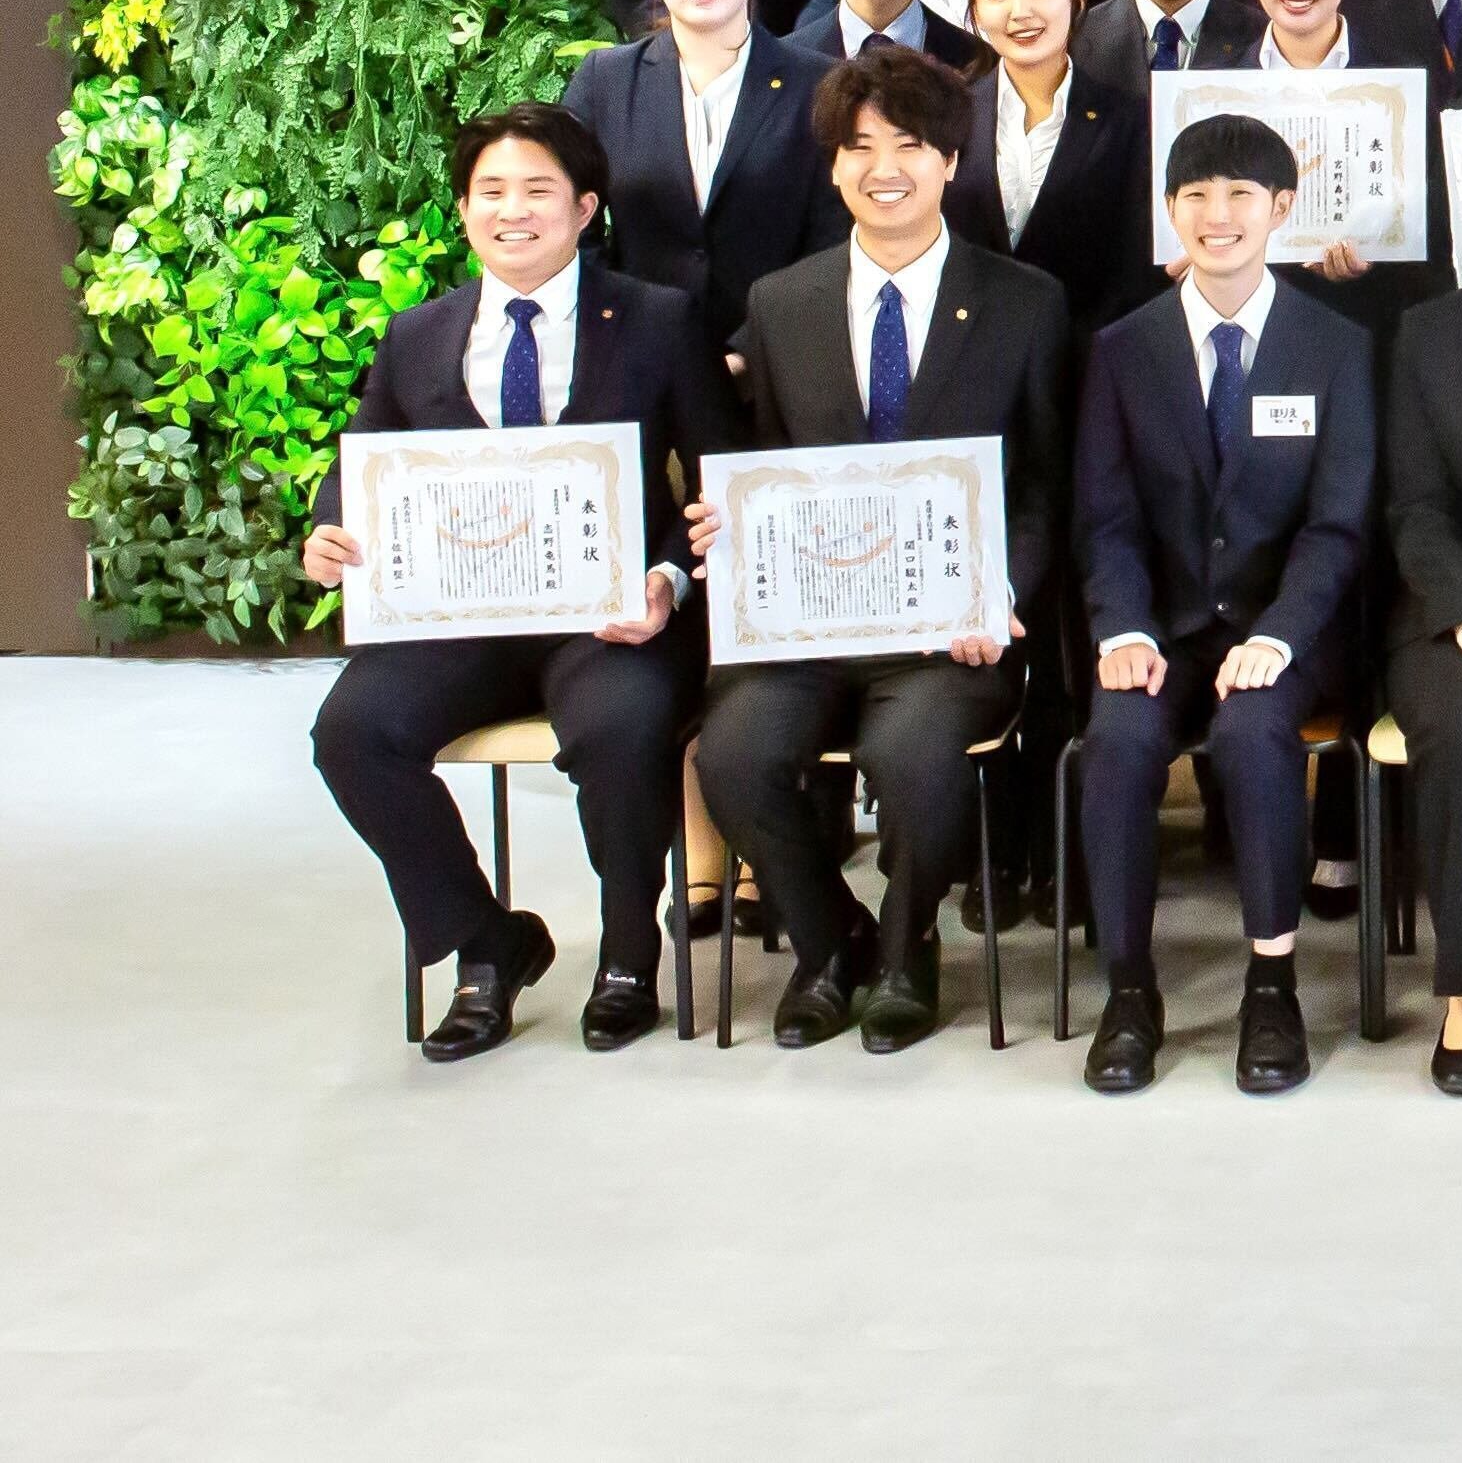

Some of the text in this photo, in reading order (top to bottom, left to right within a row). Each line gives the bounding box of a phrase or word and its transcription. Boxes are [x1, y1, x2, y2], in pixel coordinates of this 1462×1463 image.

[1368, 138, 1384, 196] 表彰状
[1269, 407, 1298, 419] ほりえ
[581, 498, 600, 562] 表彰状
[942, 514, 961, 578] 表彰状
